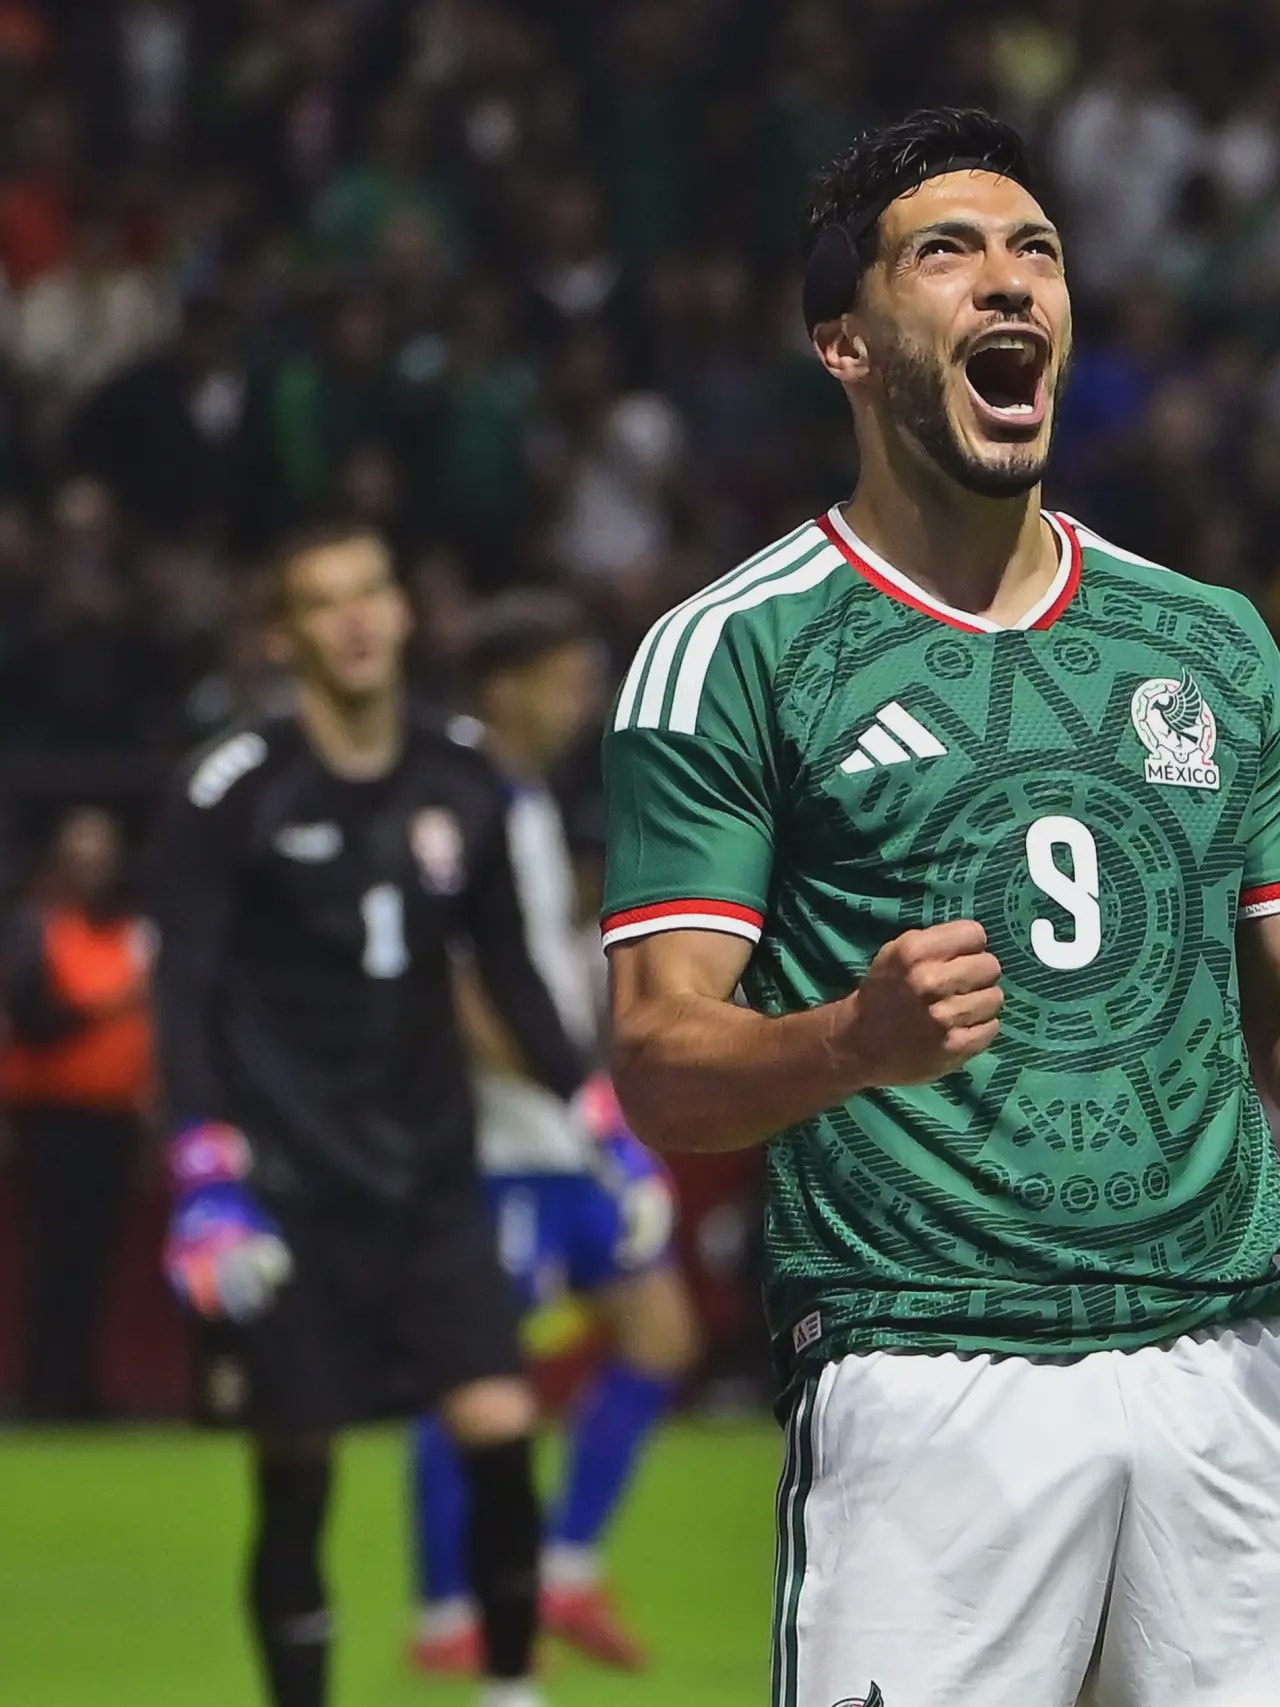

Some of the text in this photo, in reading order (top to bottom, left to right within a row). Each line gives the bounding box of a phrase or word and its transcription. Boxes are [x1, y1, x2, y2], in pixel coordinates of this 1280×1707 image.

[1147, 760, 1218, 786] MÉXICO
[360, 884, 410, 979] 1
[1025, 814, 1102, 971] 9
